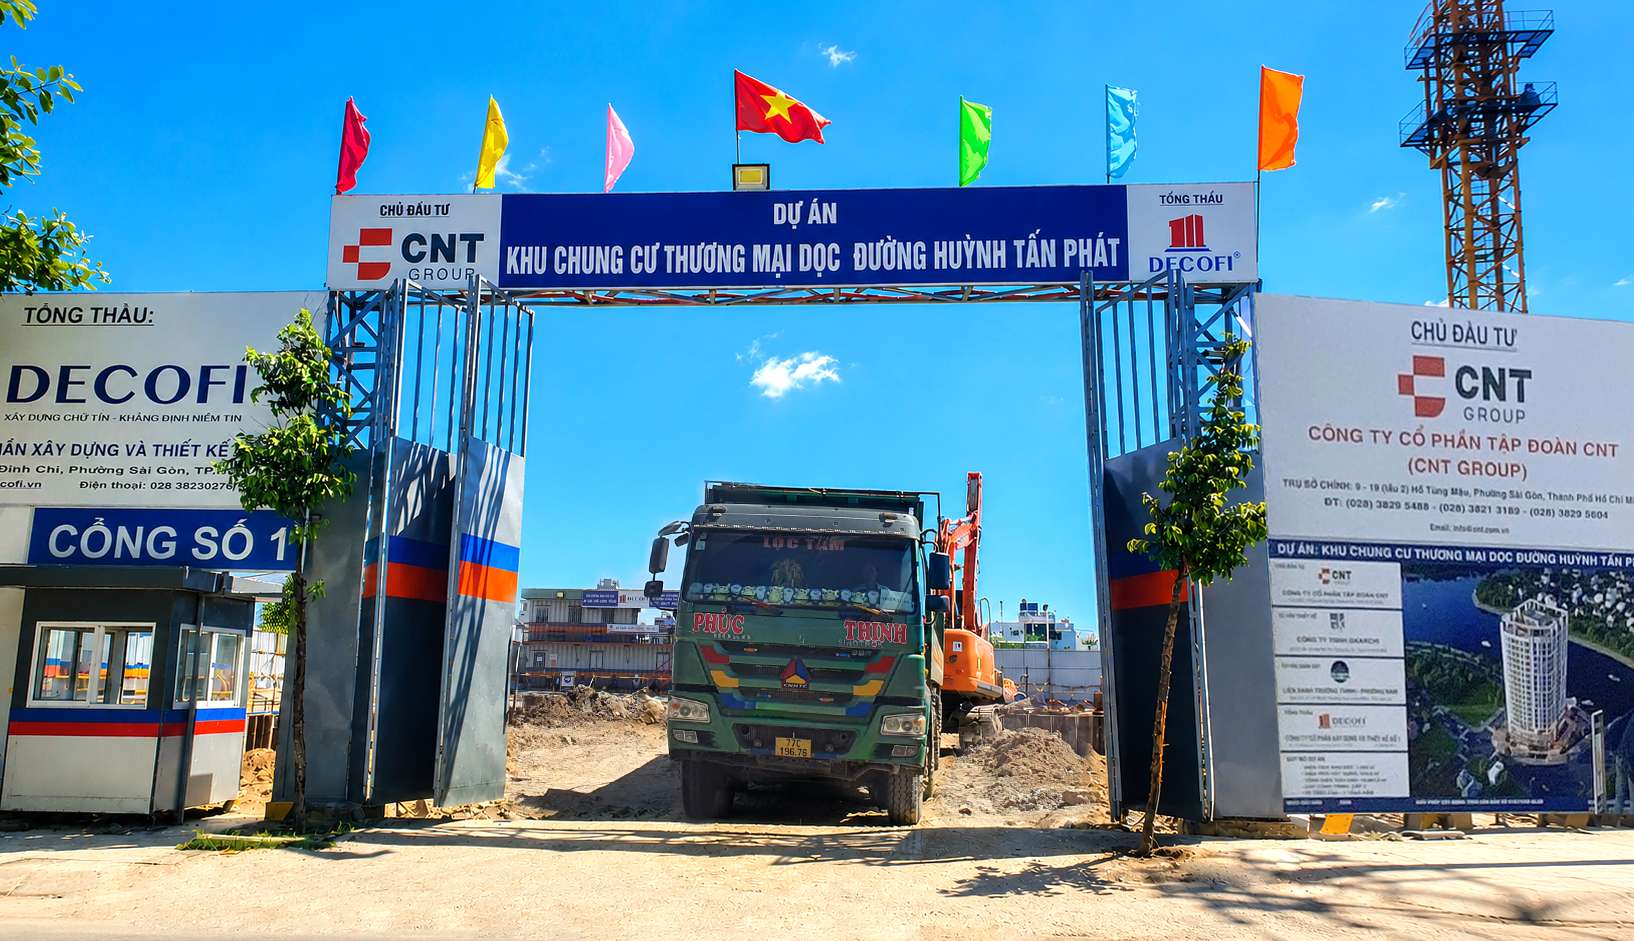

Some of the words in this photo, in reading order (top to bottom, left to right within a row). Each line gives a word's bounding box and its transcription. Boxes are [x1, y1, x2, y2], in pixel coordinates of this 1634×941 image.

[379, 201, 403, 216] CHỦ
[434, 203, 450, 216] TƯ
[773, 200, 804, 230] DỰ
[807, 197, 838, 225] ÁN
[401, 232, 485, 264] CNT
[506, 245, 548, 275] KHU
[553, 244, 624, 275] CHUNG
[630, 241, 660, 274] CƯ
[663, 241, 746, 274] THƯƠNG
[752, 243, 792, 279] MẠI
[799, 242, 841, 278] DỌC
[853, 234, 927, 271] ĐƯỜNG
[933, 232, 1007, 269] HUỲNH
[1013, 228, 1057, 268] TẤN
[1063, 231, 1121, 268] PHÁT
[408, 267, 475, 281] GROUP
[1148, 255, 1233, 273] DECOFI
[23, 302, 84, 324] TỔNG
[1410, 317, 1447, 342] CHỦ
[1493, 326, 1518, 347] TƯ
[5, 363, 248, 406] DECOFI
[1454, 364, 1533, 404] CNT
[4, 411, 26, 422] XÂY
[28, 413, 61, 423] DỰNG
[63, 412, 90, 422] CHỮ
[92, 411, 110, 422] TÍN
[223, 414, 242, 422] TIN
[1463, 405, 1526, 424] GROUP
[31, 439, 66, 457] XÂY
[70, 441, 120, 459] DỰNG
[126, 440, 147, 457] VÀ
[152, 438, 202, 457] THIẾT
[206, 438, 232, 457] KẾ
[1308, 422, 1364, 443] CÔNG
[1369, 428, 1393, 445] TY
[1399, 424, 1426, 447] CỔ
[1431, 428, 1481, 451] PHẦN
[1487, 432, 1522, 456] TẬP
[1527, 436, 1578, 456] ĐOÀN
[1582, 441, 1620, 458] CNT
[35, 465, 64, 475] Chi,
[68, 465, 124, 476] Phường
[128, 465, 152, 475] Sài
[156, 466, 190, 476] Gòn,
[1408, 457, 1451, 475] (CNT
[1456, 459, 1528, 482] GROUP)
[79, 481, 107, 490] Điện
[111, 481, 146, 491] thoại:
[150, 481, 172, 490] 028
[47, 516, 178, 560] CỔNG
[190, 517, 254, 561] SỐ
[268, 526, 287, 561] 1
[1321, 545, 1347, 557] KHU
[1349, 546, 1392, 558] CHUNG
[1414, 547, 1463, 561] THƯƠNG
[1516, 550, 1557, 565] ĐƯỜNG
[1559, 553, 1599, 567] HUỲNH
[1331, 570, 1352, 580] CNT
[785, 739, 802, 748] 77C
